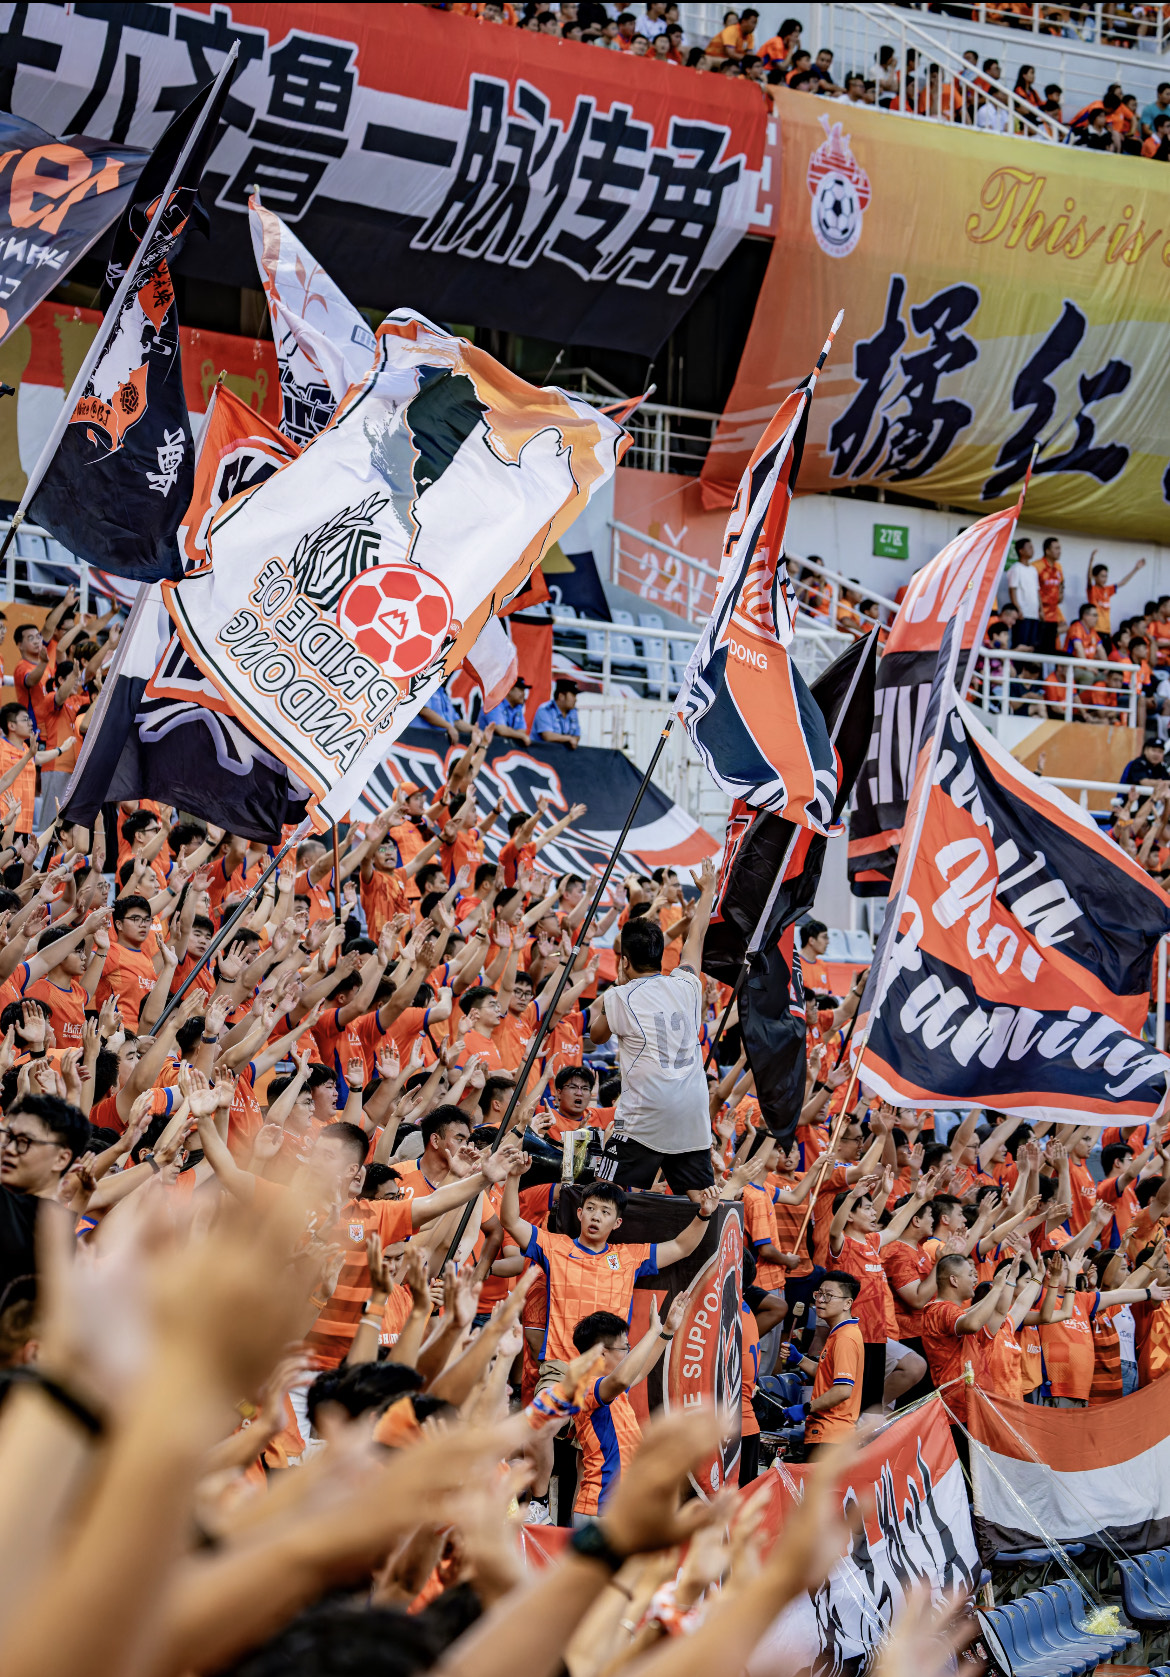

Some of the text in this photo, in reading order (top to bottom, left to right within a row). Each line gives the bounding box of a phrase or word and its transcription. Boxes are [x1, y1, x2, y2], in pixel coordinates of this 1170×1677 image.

[965, 166, 1163, 265] This is
[827, 272, 1170, 502] 橘红
[727, 637, 768, 670] DONG
[653, 1011, 695, 1069] 12
